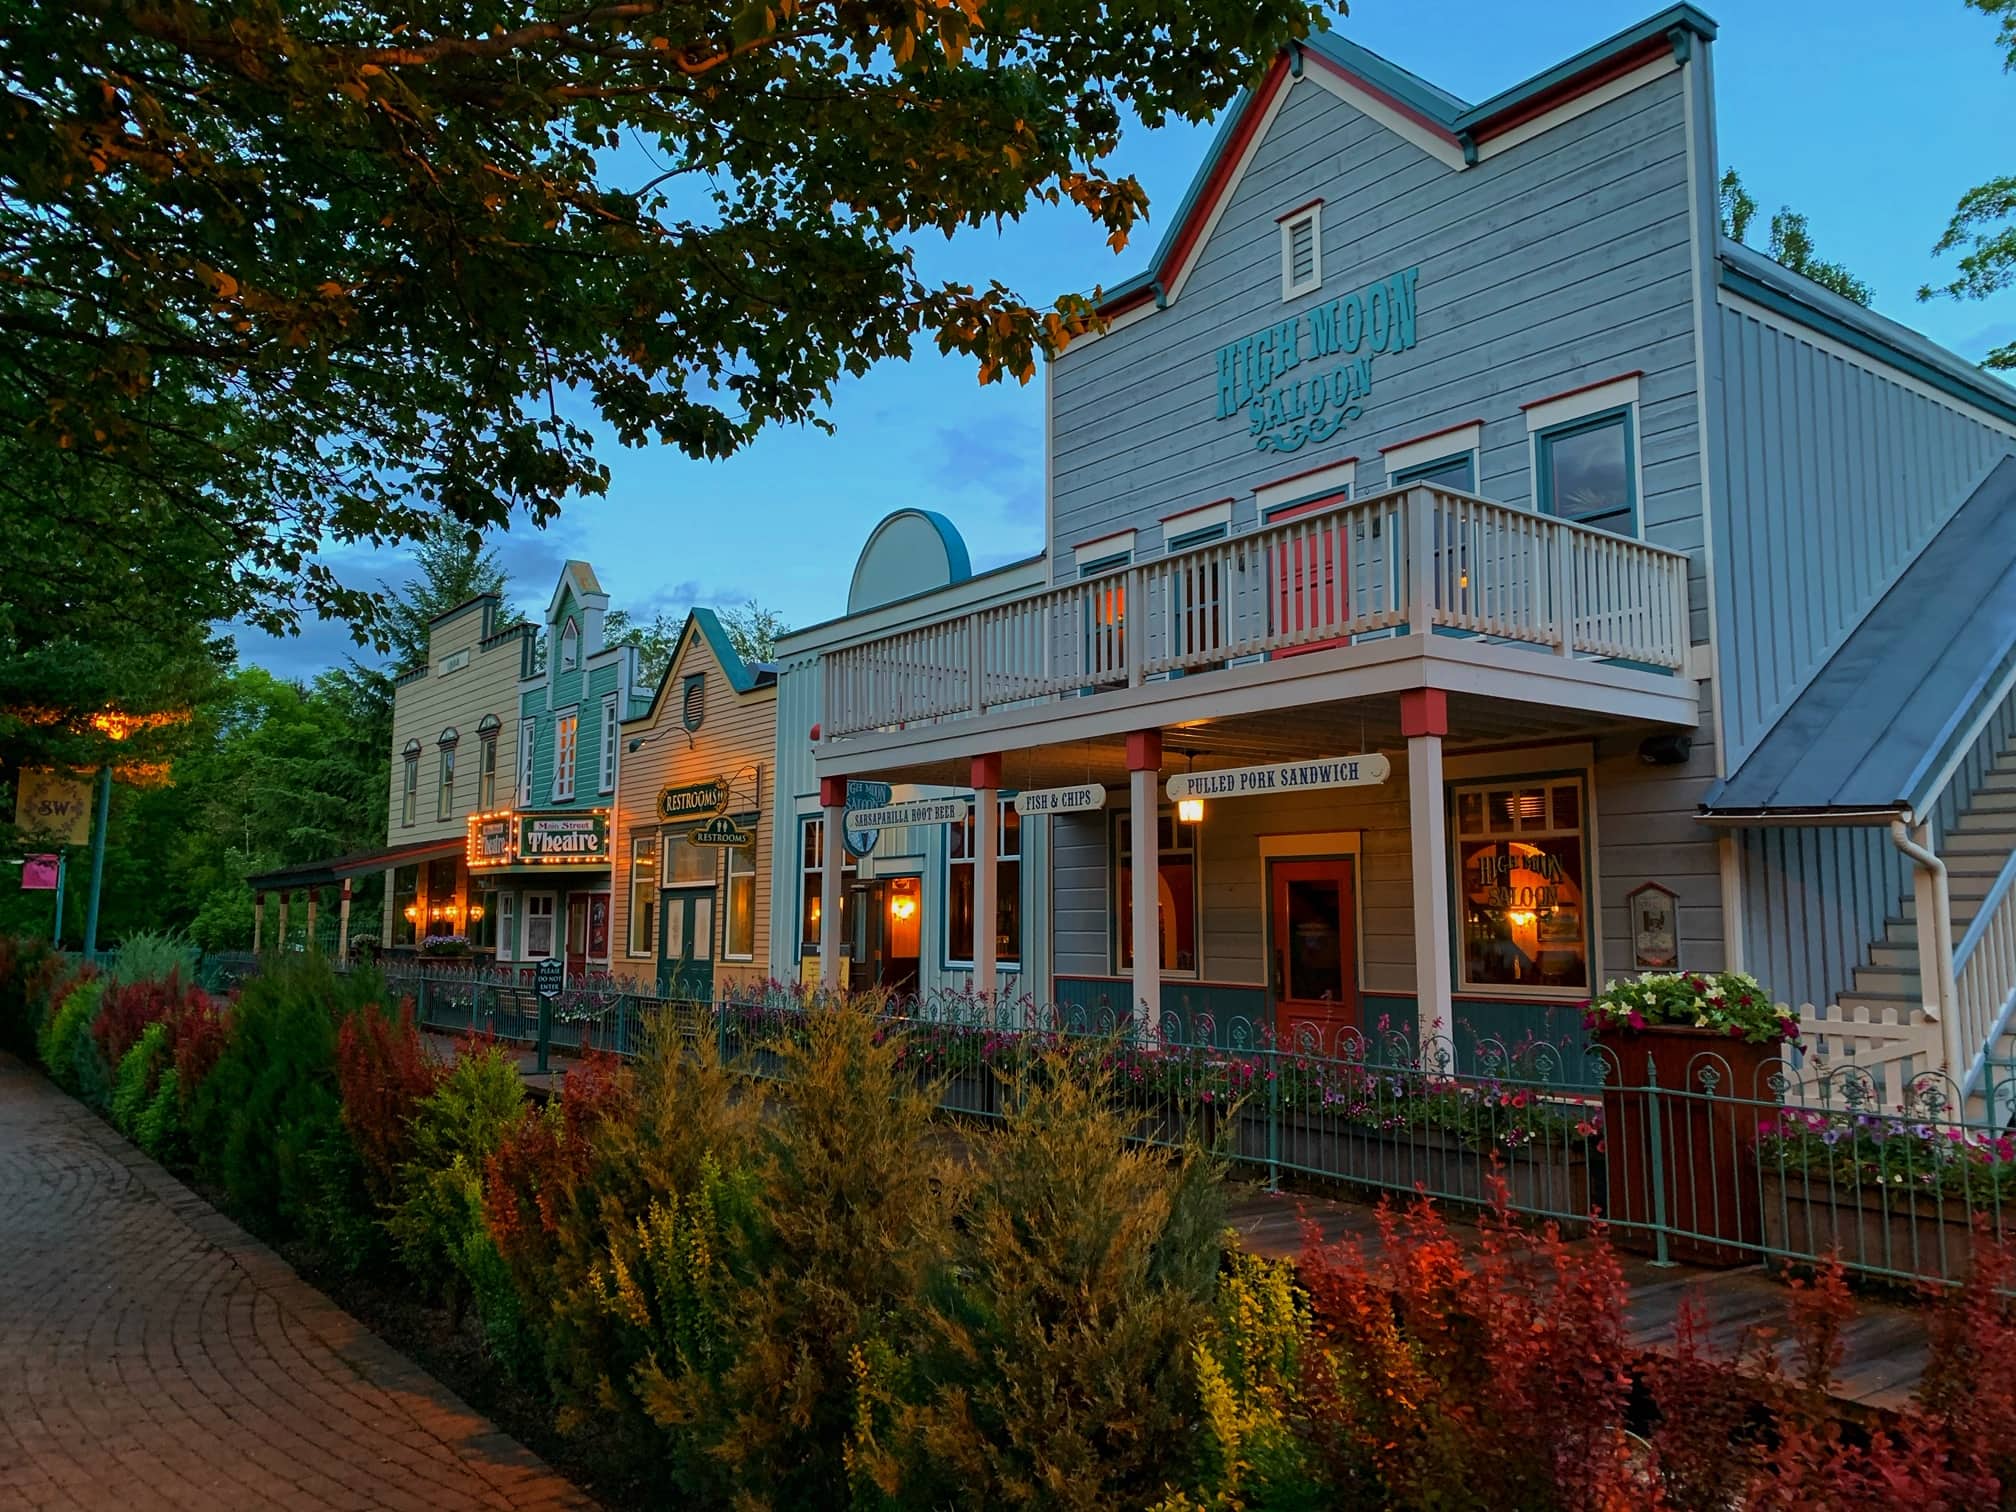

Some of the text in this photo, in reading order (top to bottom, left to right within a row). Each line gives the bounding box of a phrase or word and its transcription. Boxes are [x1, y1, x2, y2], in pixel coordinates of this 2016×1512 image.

[1216, 267, 1420, 421] HIGH MOON
[1249, 353, 1375, 437] SALOON
[1187, 762, 1360, 795] PULLED PORK SANDWICH
[666, 788, 718, 812] RESTROOMS
[846, 783, 863, 797] IGH
[1025, 789, 1091, 811] FISH & CHIPS
[38, 800, 69, 817] SW
[854, 805, 956, 827] SARSAPARILLA ROOT BEER
[527, 832, 598, 853] Theatre
[697, 833, 747, 843] RESTROOMS
[1479, 854, 1565, 886] HIGH MOON
[1488, 886, 1558, 907] SALOON
